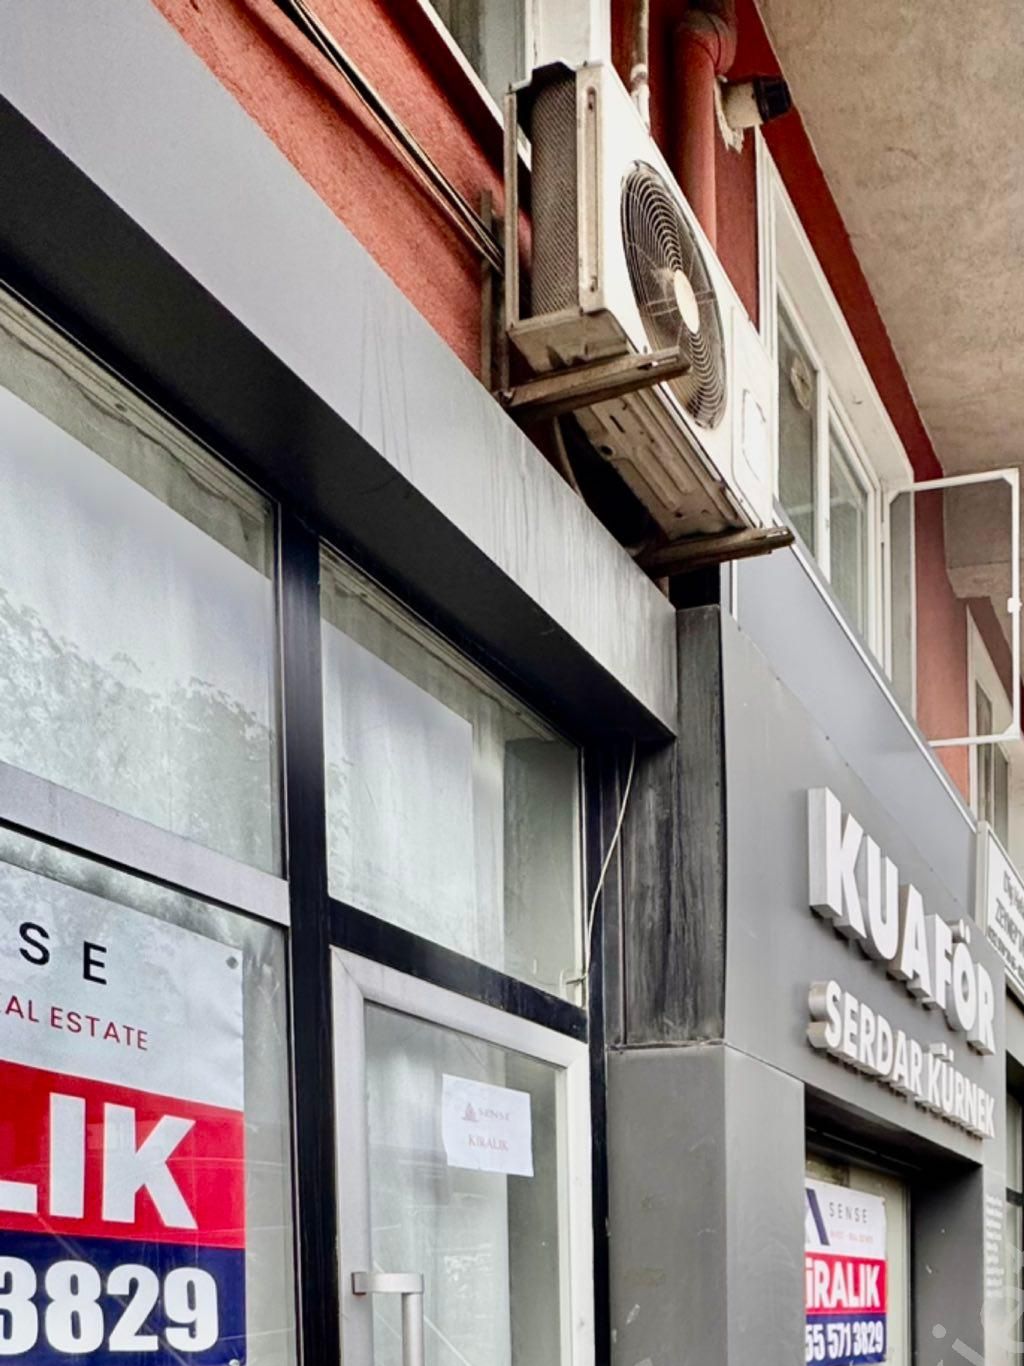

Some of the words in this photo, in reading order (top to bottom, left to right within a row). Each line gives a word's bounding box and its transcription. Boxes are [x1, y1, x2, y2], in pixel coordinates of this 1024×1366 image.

[808, 786, 996, 1055] KUAFÖR
[50, 1005, 149, 1052] ESTATE
[808, 979, 923, 1098] SERDAR
[926, 1042, 996, 1139] KÜRNEK
[828, 1201, 868, 1224] SENSE
[0, 1255, 220, 1356] 3829
[852, 1320, 884, 1356] 3829
